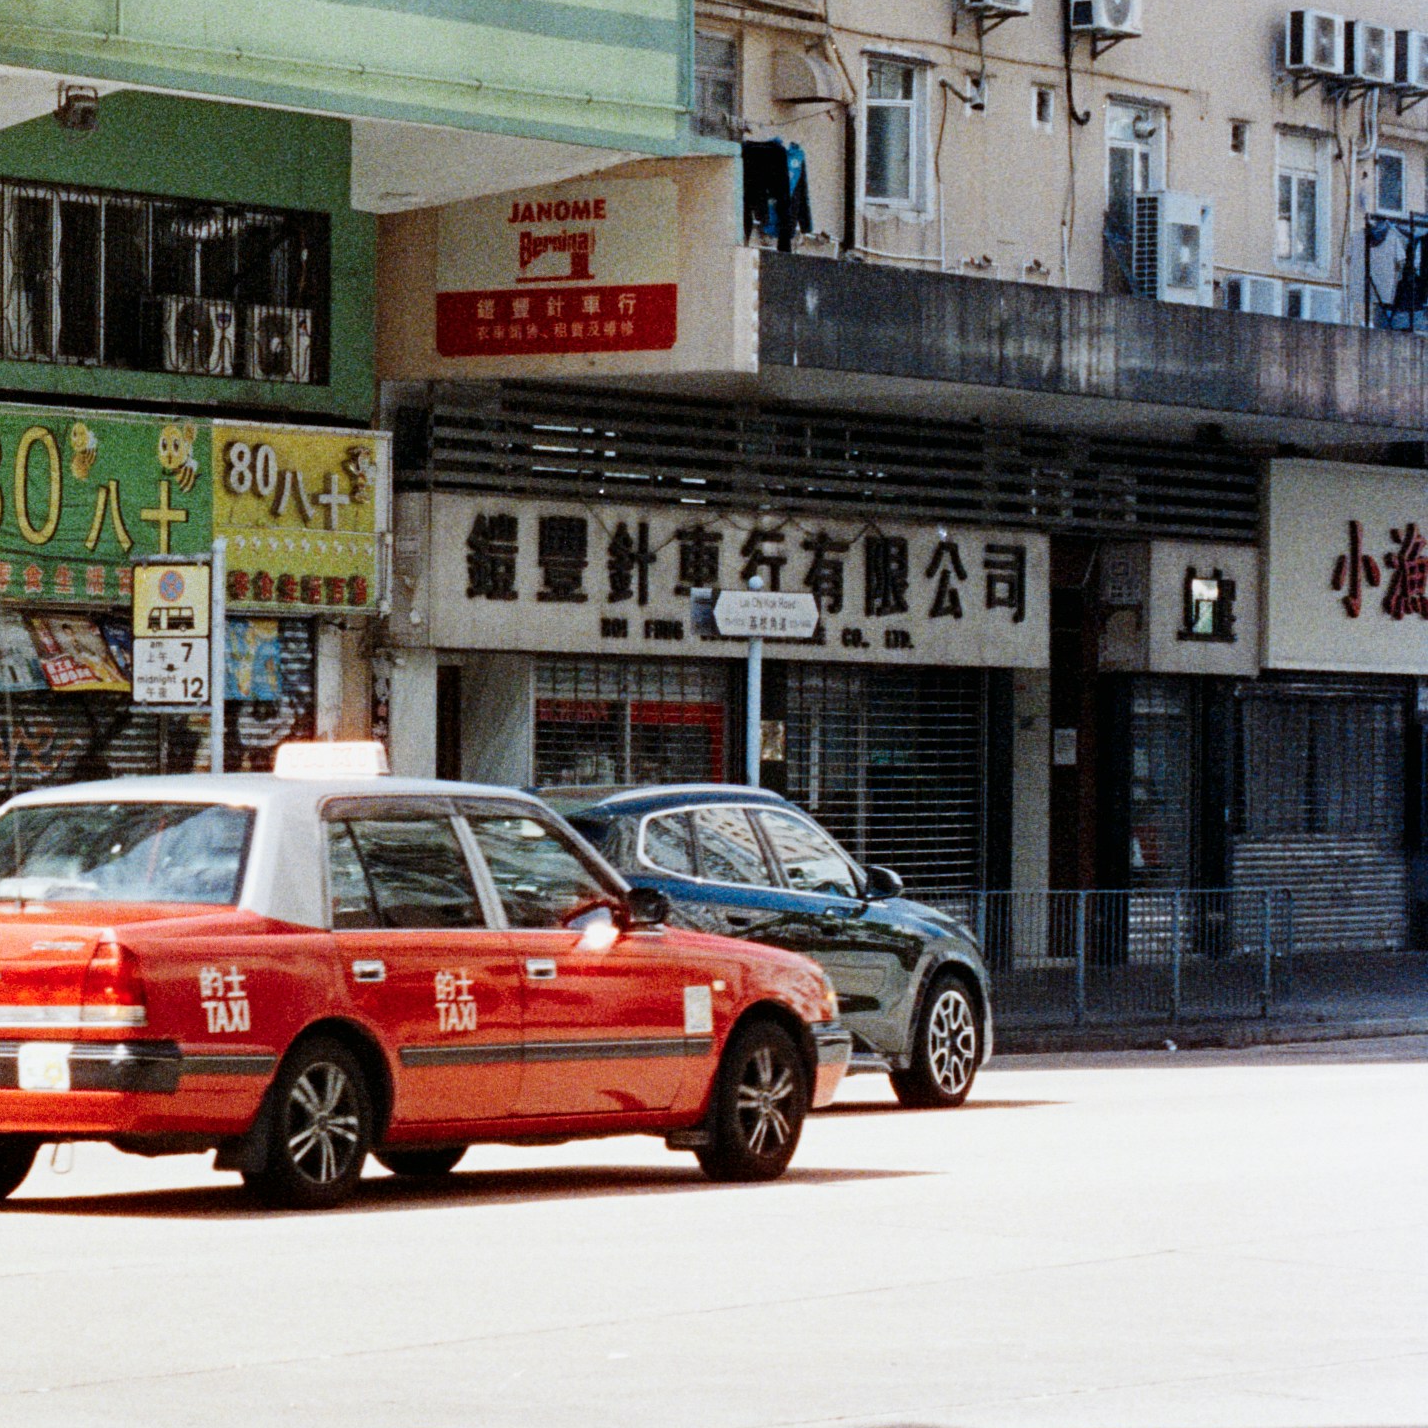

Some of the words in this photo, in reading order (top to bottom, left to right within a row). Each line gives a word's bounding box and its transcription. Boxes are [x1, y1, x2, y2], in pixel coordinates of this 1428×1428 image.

[508, 198, 607, 223] JANOME
[229, 442, 278, 497] 80
[276, 471, 350, 531] 八十
[84, 480, 189, 555] 八十
[150, 641, 164, 649] am
[841, 628, 870, 648] CO.
[146, 652, 168, 663] 上午
[180, 642, 193, 663] 7
[136, 675, 177, 686] midnight
[181, 677, 204, 698] 12
[199, 966, 246, 998] 的士
[434, 968, 474, 1001] 的士
[201, 999, 251, 1034] TAXI
[435, 1001, 477, 1032] TAXI
